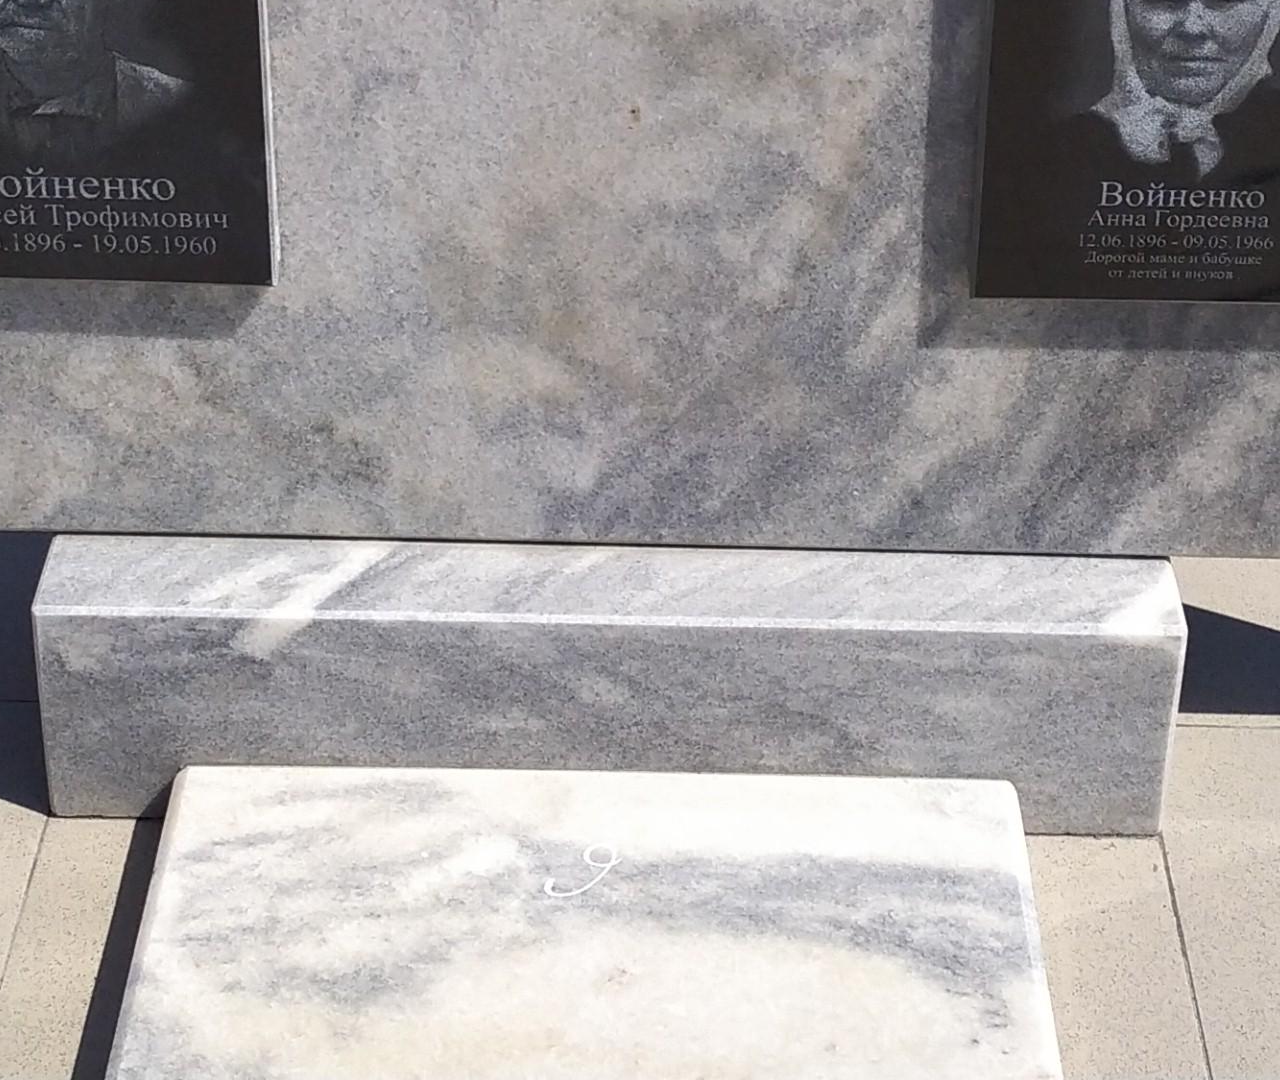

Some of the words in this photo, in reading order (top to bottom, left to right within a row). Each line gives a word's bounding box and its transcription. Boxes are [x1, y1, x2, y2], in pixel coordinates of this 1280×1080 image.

[1098, 181, 1265, 208] Войненко
[45, 204, 230, 233] Трофимович
[1087, 209, 1146, 228] Анна
[1154, 210, 1270, 231] Гордеевна
[93, 234, 216, 255] 19.05.1960
[1078, 233, 1167, 249] 12.06.1896
[1183, 234, 1274, 250] 09.05.1966
[1084, 251, 1145, 265] Дорогой
[1149, 254, 1185, 265] маме
[1189, 255, 1198, 265] и
[1202, 252, 1264, 268] бабушке
